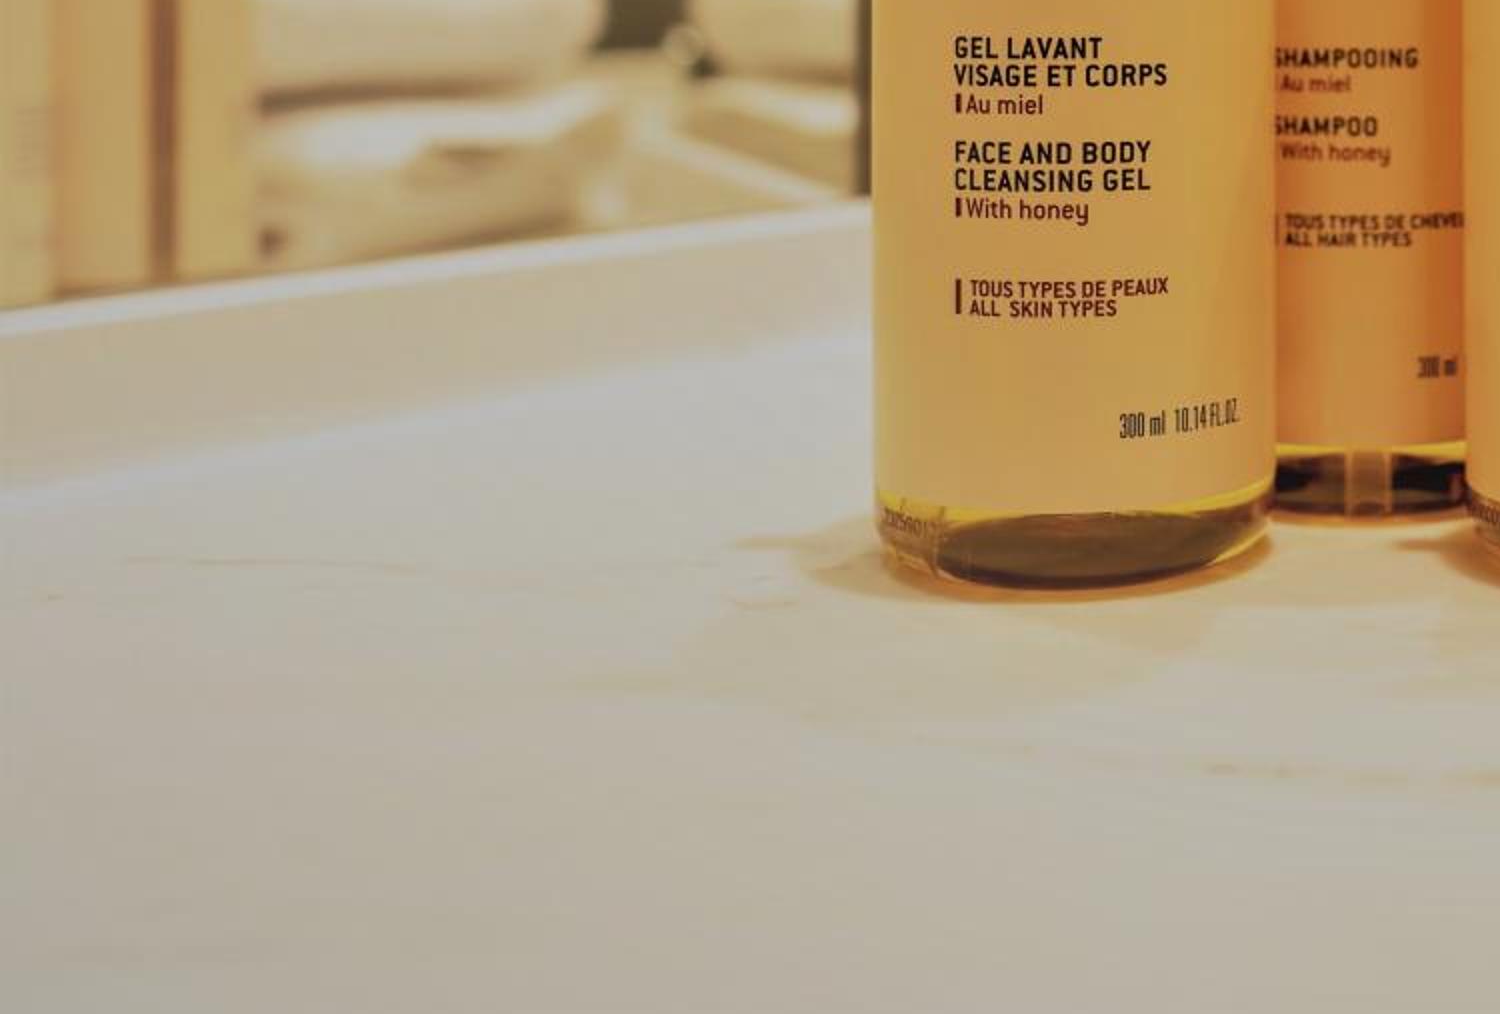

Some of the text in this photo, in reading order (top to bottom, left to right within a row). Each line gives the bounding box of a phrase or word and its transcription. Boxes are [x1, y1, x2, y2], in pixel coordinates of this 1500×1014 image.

[954, 35, 1103, 61] GEL LAVANT
[953, 62, 1168, 88] VISAGE ET CORPS
[1278, 73, 1352, 94] Au miel
[965, 93, 1044, 116] Au miel
[954, 139, 1152, 165] FACE AND BODY
[1327, 142, 1392, 169] honey
[954, 167, 1152, 193] CLEANSING GEL
[965, 196, 1089, 227] With honey
[1327, 213, 1381, 233] TYPES
[1383, 212, 1407, 232] DE
[1316, 230, 1358, 248] HAIR
[1360, 229, 1413, 248] TYPES
[969, 276, 1169, 300] TOUS TYPES DE PEAUX
[969, 296, 1118, 319] ALL SKIN TYPES
[1119, 411, 1146, 440] 300
[1148, 409, 1167, 437] ml
[1173, 403, 1208, 434] 10.14
